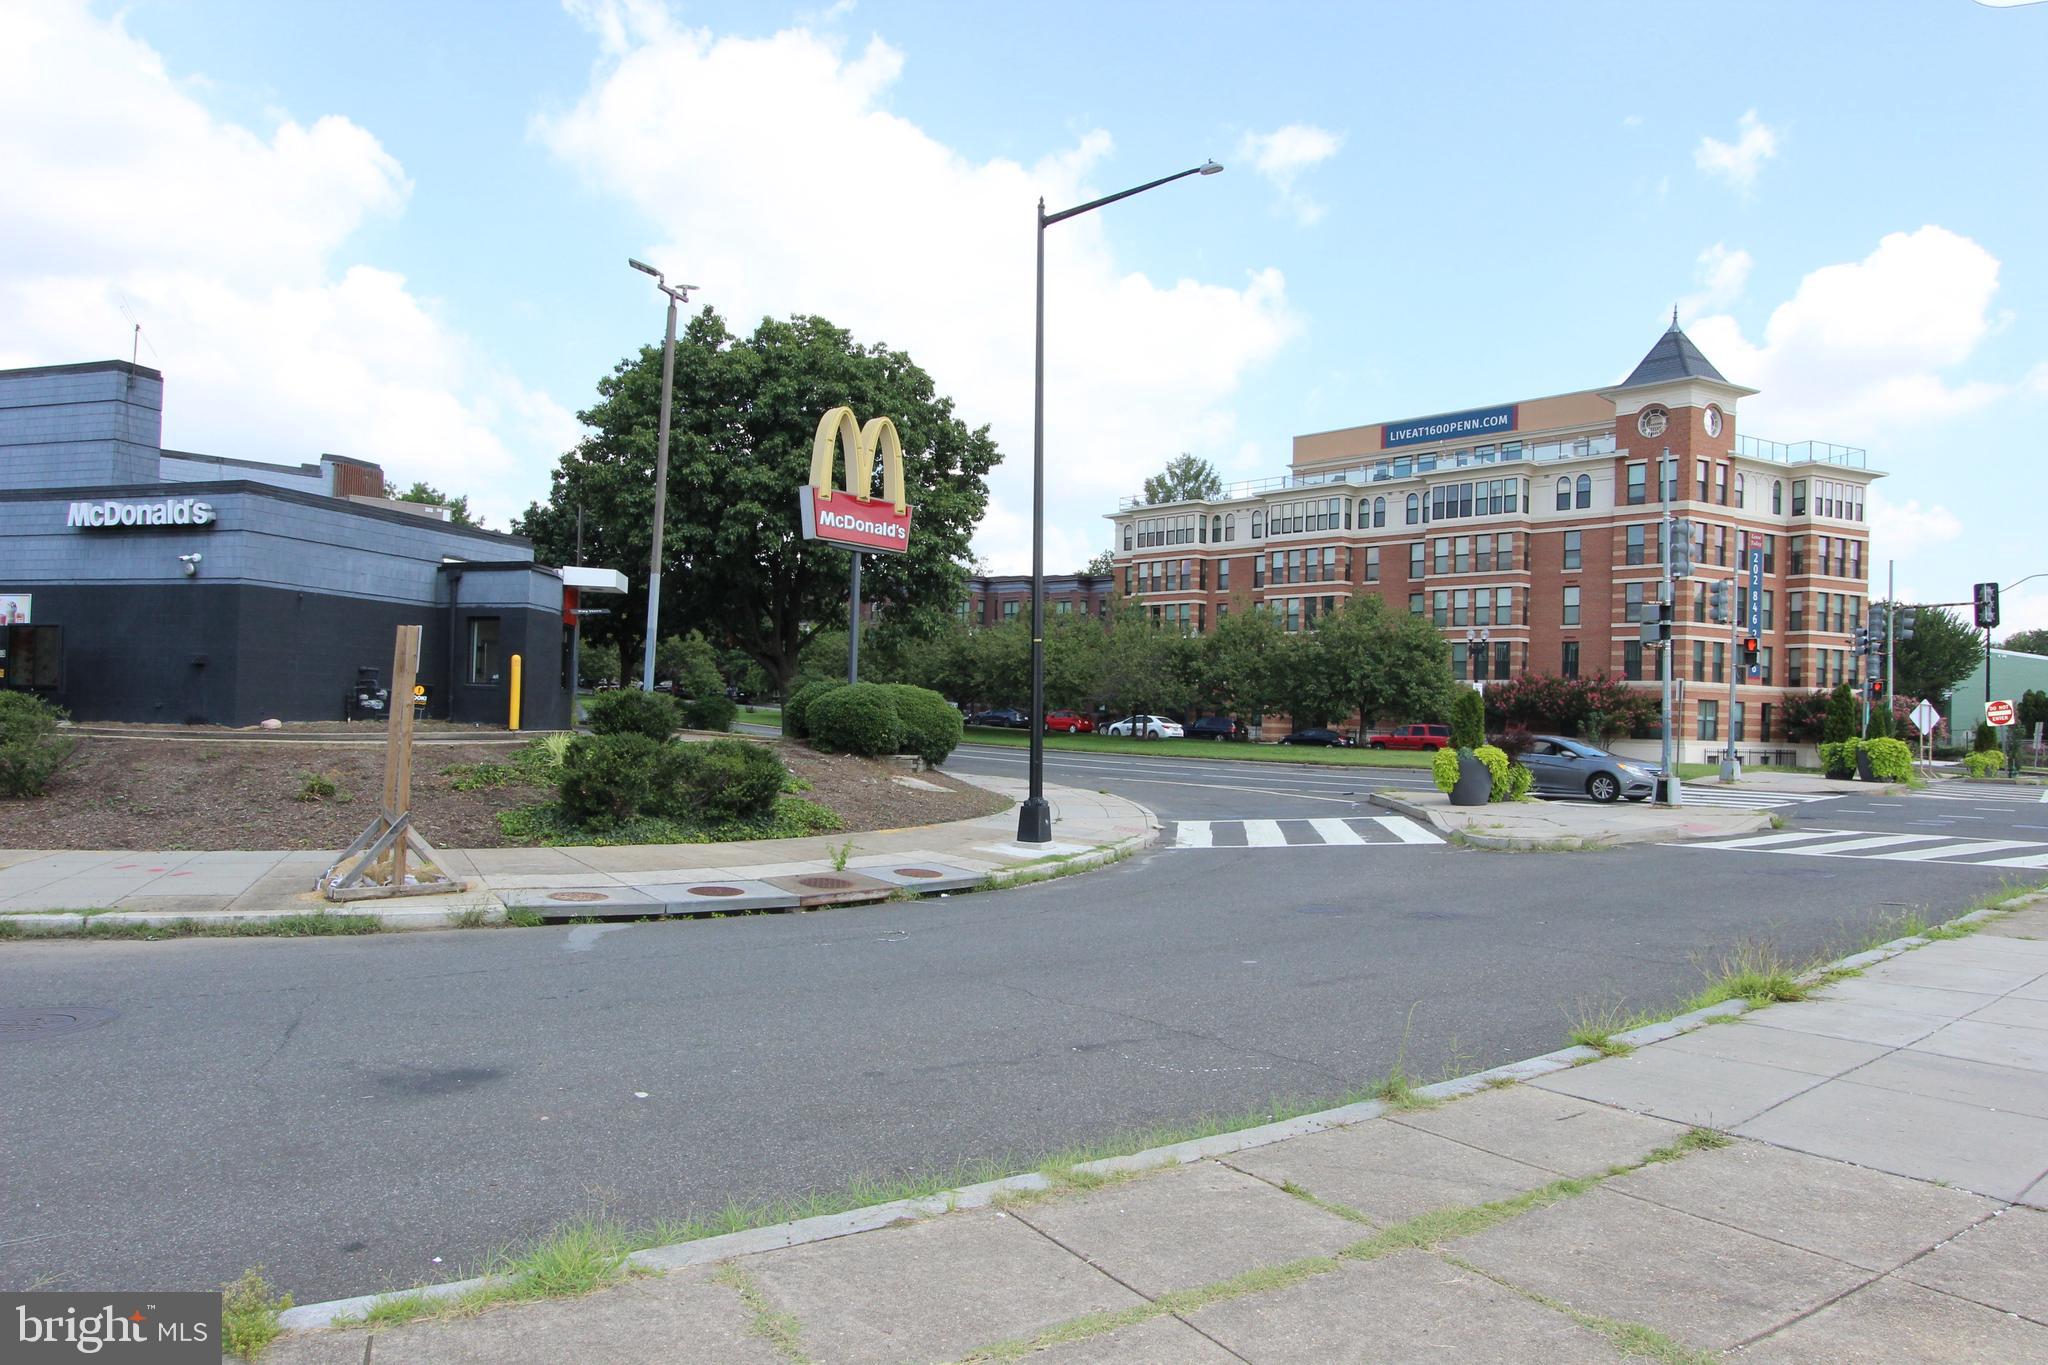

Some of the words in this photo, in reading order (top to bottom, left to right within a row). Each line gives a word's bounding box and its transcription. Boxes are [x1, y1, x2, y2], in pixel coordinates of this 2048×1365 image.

[1390, 415, 1508, 440] LIVEAT1600PENN.COM
[67, 499, 215, 527] McDonald's
[820, 510, 906, 539] McDonald's
